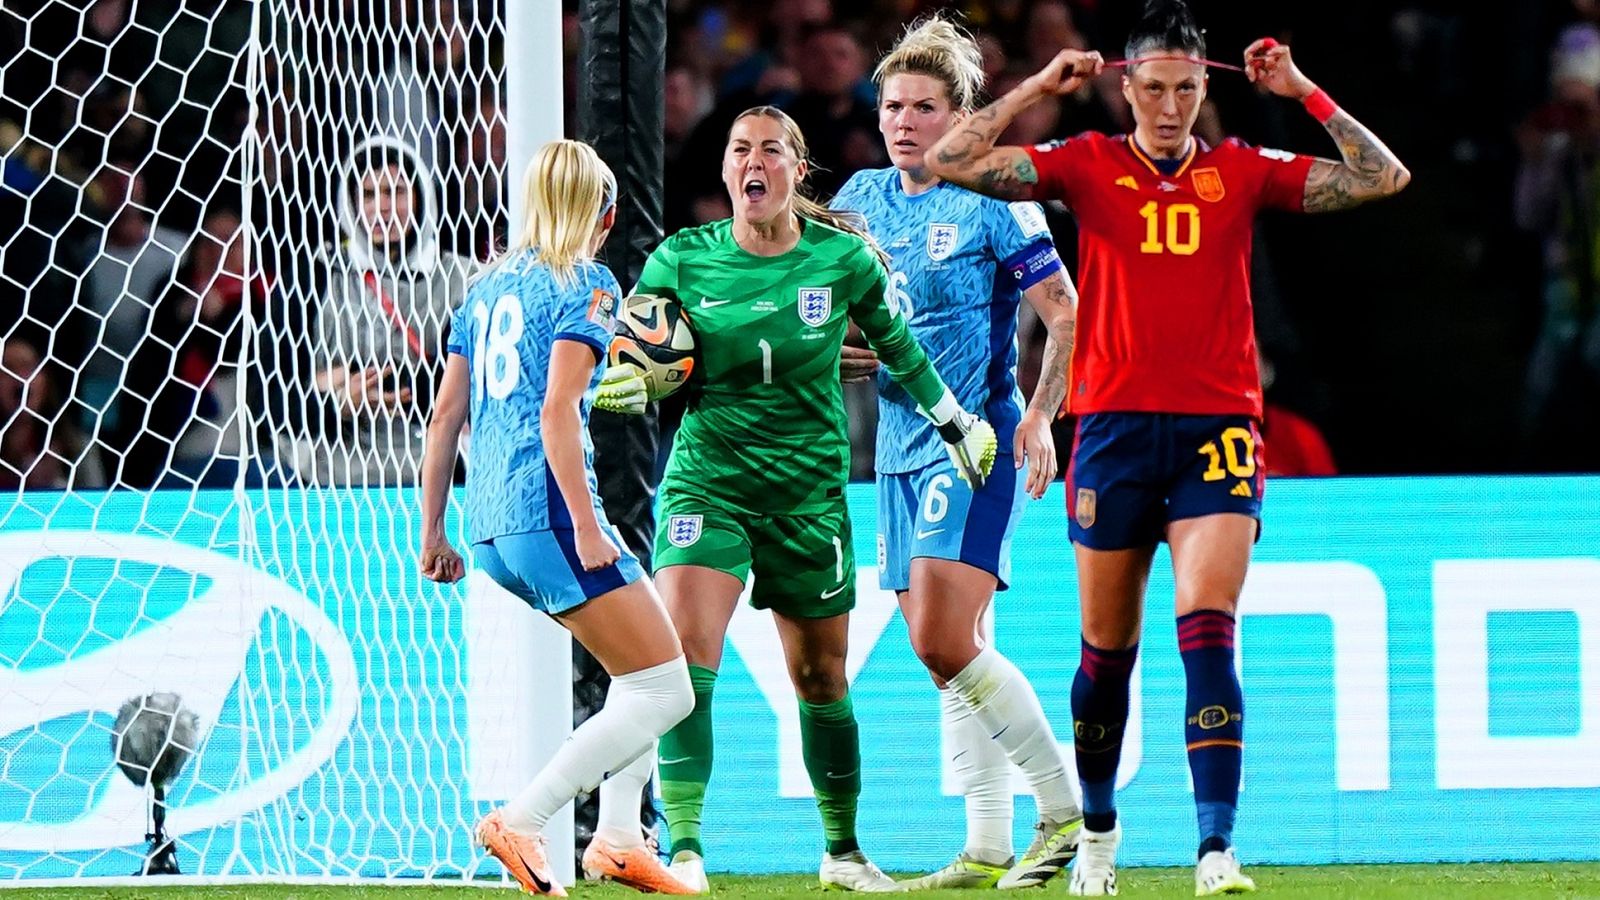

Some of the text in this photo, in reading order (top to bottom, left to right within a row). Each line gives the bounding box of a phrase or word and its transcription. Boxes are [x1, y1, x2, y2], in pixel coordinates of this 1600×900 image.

[1139, 201, 1200, 255] 10
[890, 271, 914, 321] 6
[473, 293, 524, 402] 18
[758, 338, 772, 384] 1
[1198, 427, 1255, 482] 10
[923, 473, 953, 523] 6
[832, 535, 843, 582] 1
